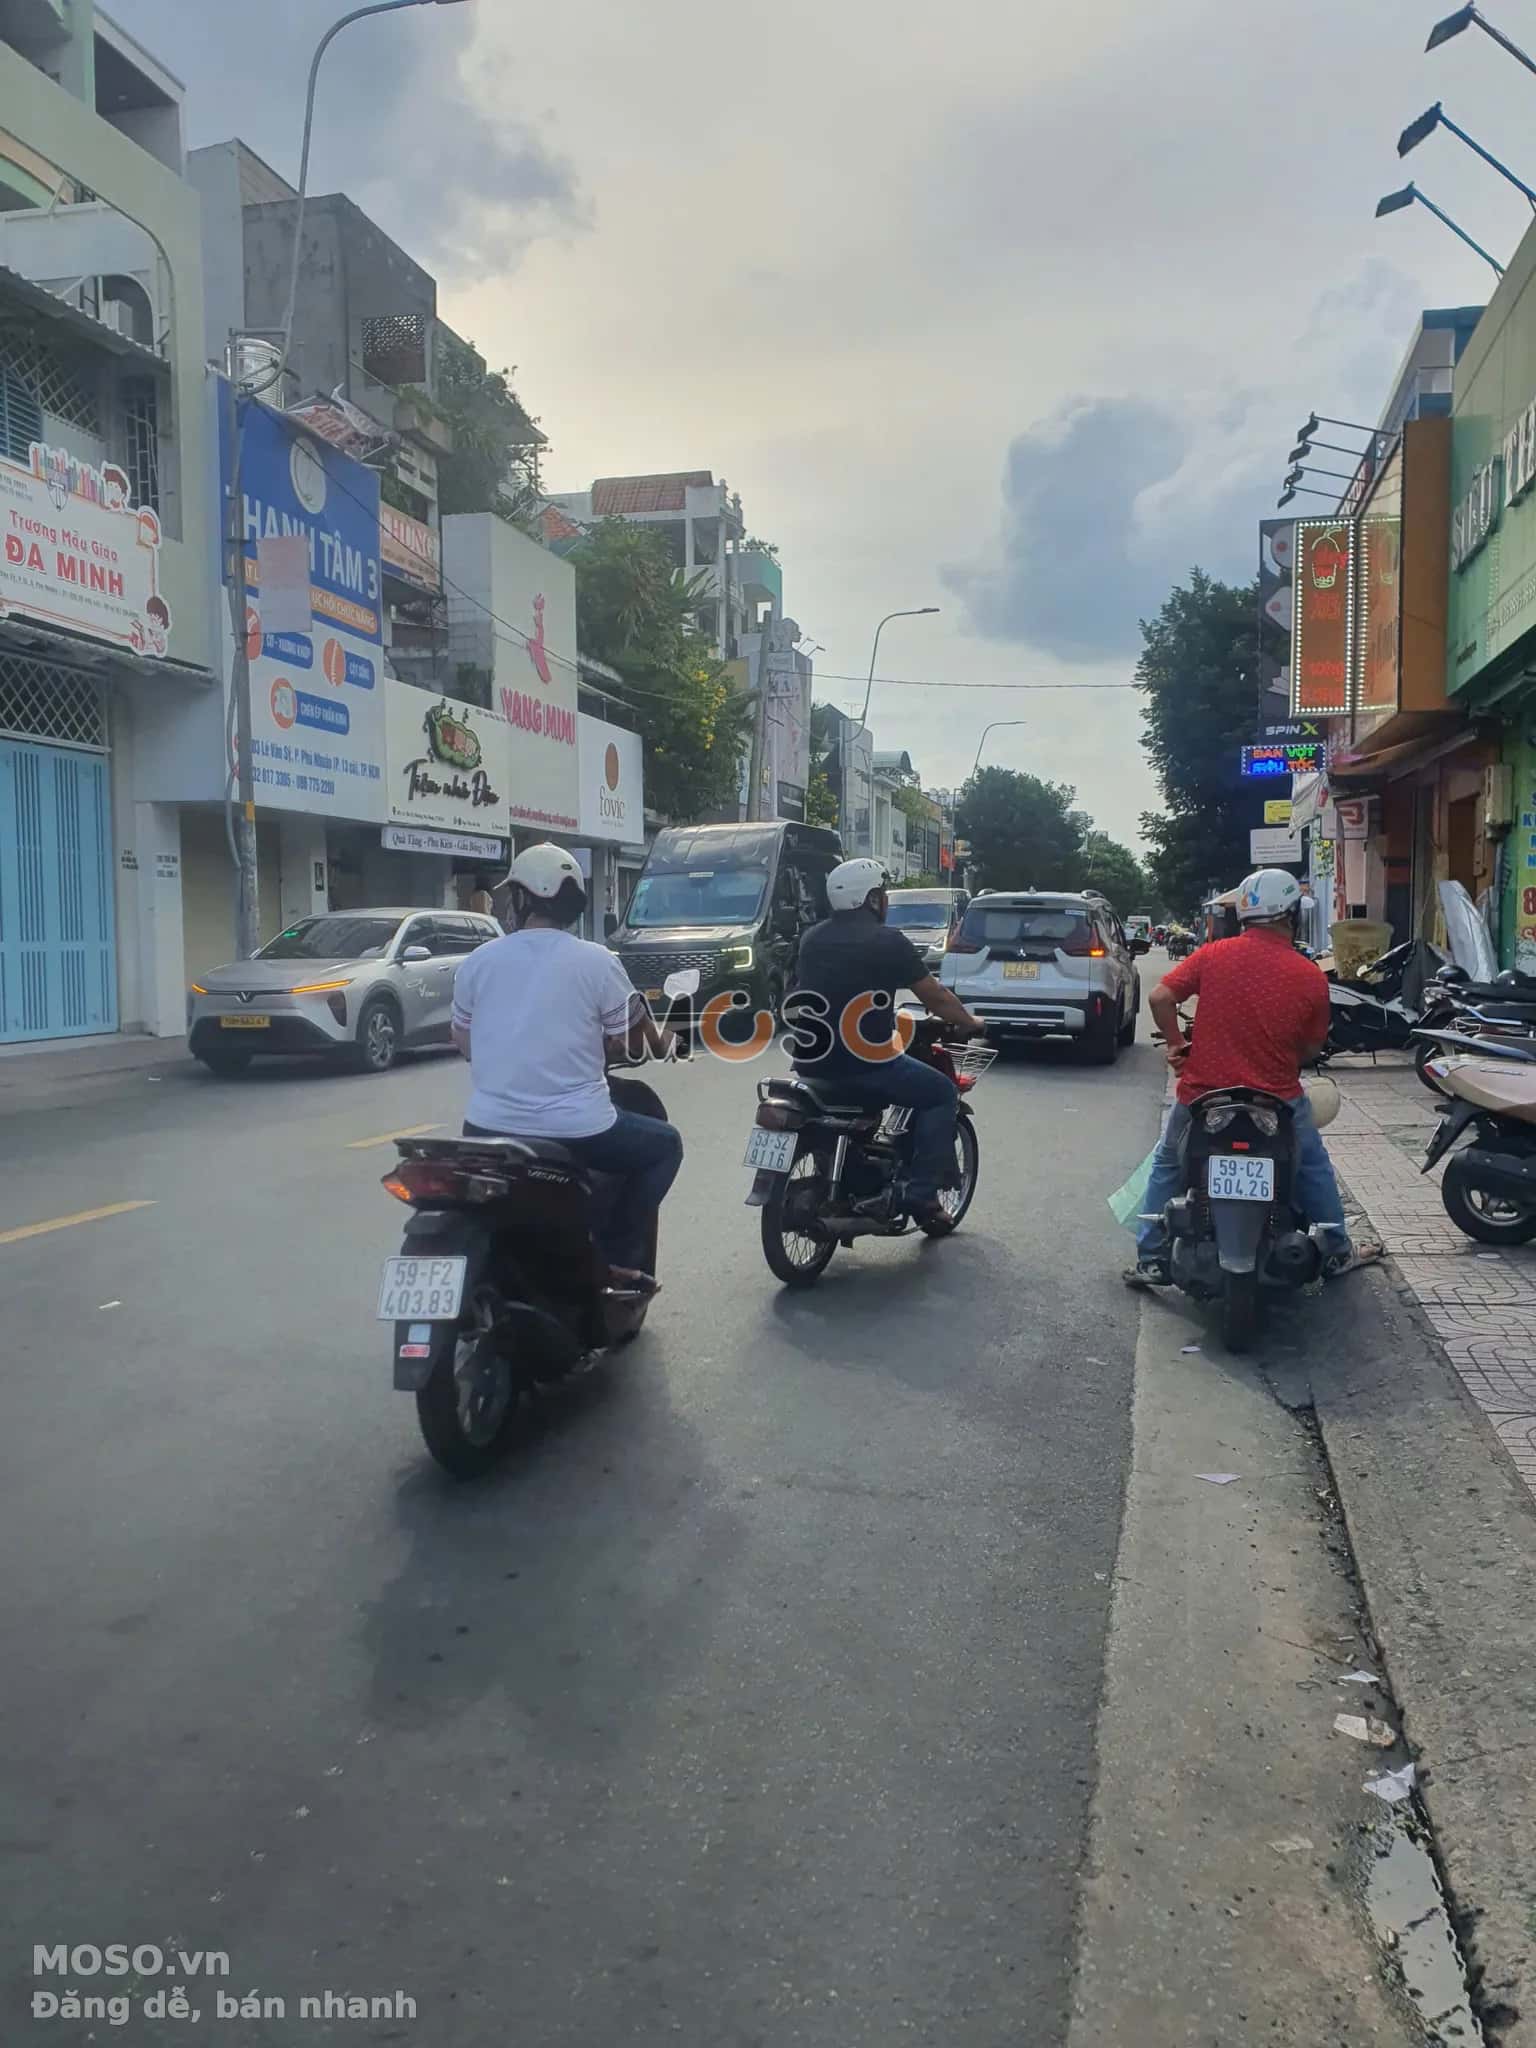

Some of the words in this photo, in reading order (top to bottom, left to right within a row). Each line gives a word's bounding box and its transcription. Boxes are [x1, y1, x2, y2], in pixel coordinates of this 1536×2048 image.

[5, 533, 46, 574] ĐA
[57, 551, 124, 599] MINH
[320, 530, 363, 594] TÂM
[367, 558, 378, 600] 3
[750, 1149, 785, 1169] 9116
[1219, 1159, 1264, 1178] 59-C2
[1213, 1177, 1269, 1198] 504.26
[394, 1262, 453, 1287] 59-F2
[384, 1289, 454, 1315] 403.83
